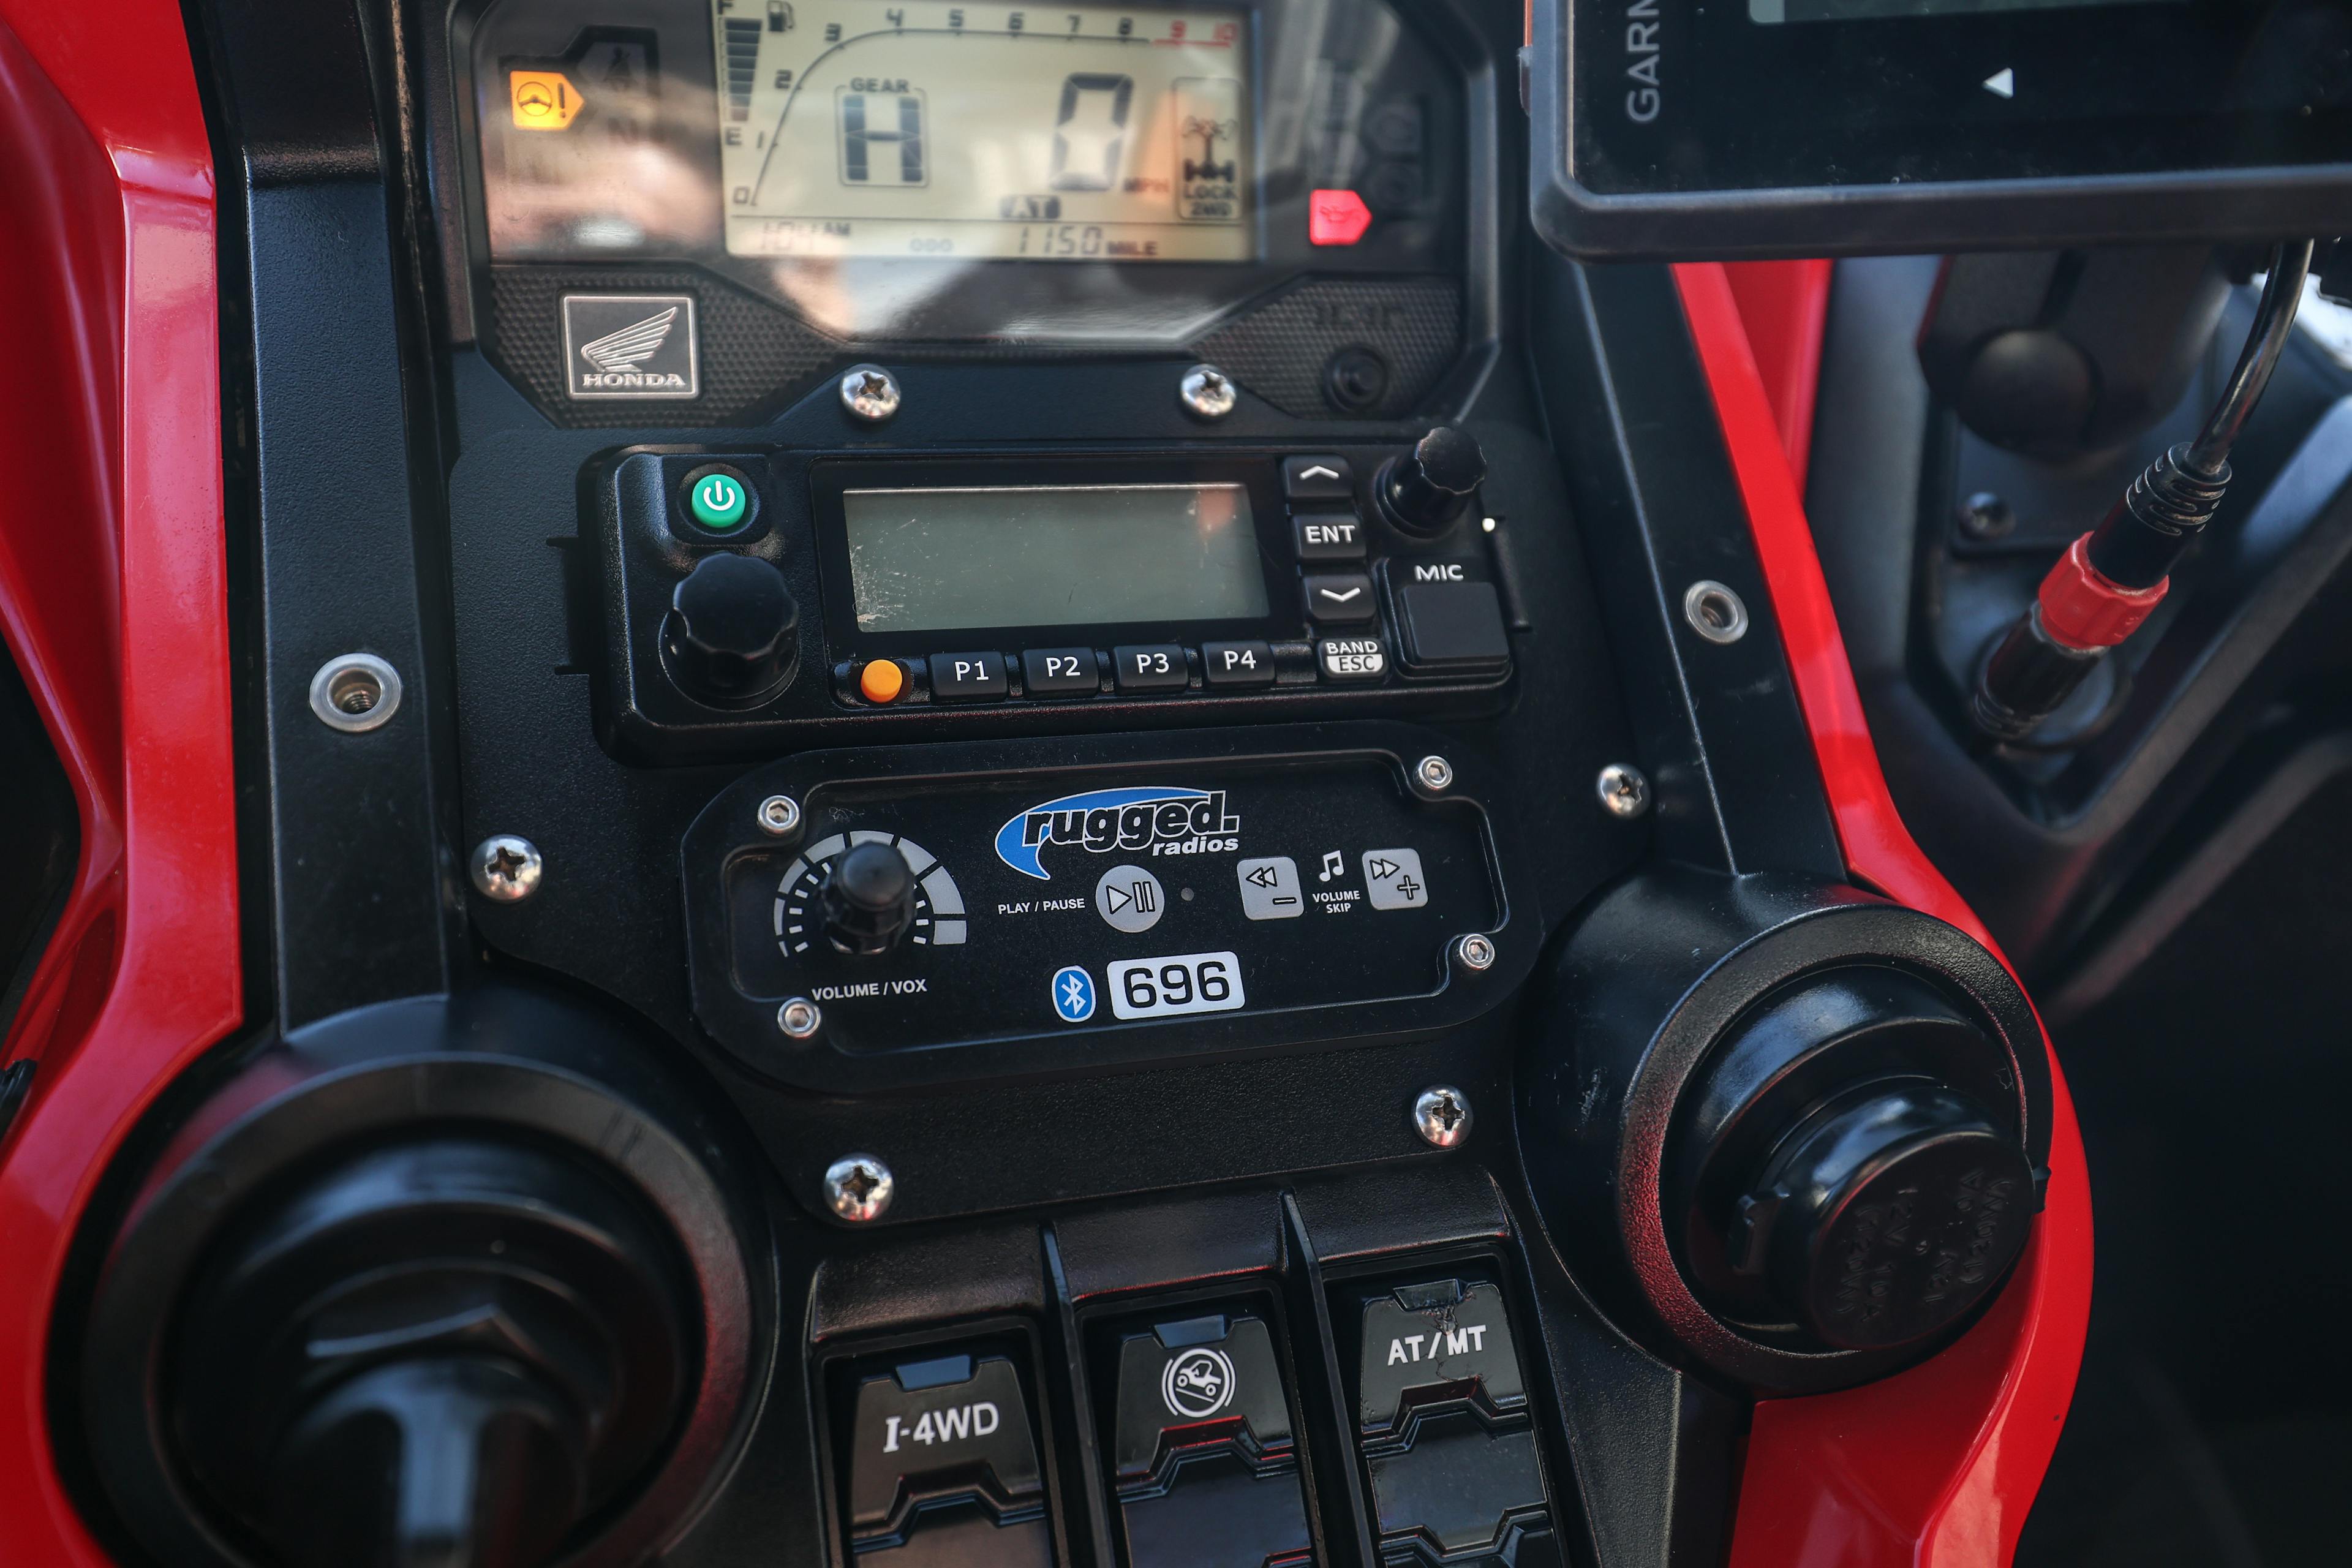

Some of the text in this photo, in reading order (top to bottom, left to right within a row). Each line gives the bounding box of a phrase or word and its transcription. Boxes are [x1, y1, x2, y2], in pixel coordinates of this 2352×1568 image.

[825, 9, 1238, 41] 3 4 5 6 7 8 9 10
[775, 69, 793, 89] 2
[850, 77, 910, 92] GEAR
[725, 127, 742, 146] E
[756, 131, 764, 149] 1
[843, 95, 922, 181] H
[1050, 72, 1134, 191] 0
[733, 186, 750, 205] 0
[1184, 184, 1237, 200] LOCK
[1019, 225, 1158, 256] 1150 MILE
[582, 373, 686, 389] HONDA
[1305, 525, 1355, 544] ENT
[1414, 564, 1464, 582] MIC
[1325, 640, 1378, 655] BAND
[1046, 655, 1080, 677] P2
[1136, 652, 1170, 674] P3
[1224, 649, 1257, 669] P4
[1339, 655, 1376, 672] ESC
[954, 660, 989, 681] P1
[1152, 835, 1240, 856] radios
[998, 902, 1030, 915] PLAY
[1043, 898, 1085, 912] PAUSE
[1312, 890, 1361, 903] VOLUME
[1326, 902, 1352, 914] SKIP
[811, 982, 880, 1001] VOLUME
[891, 979, 927, 995] VOX
[1123, 961, 1231, 1009] 696
[1387, 1324, 1487, 1366] AT/MT
[883, 1401, 1000, 1453] I-4WD
